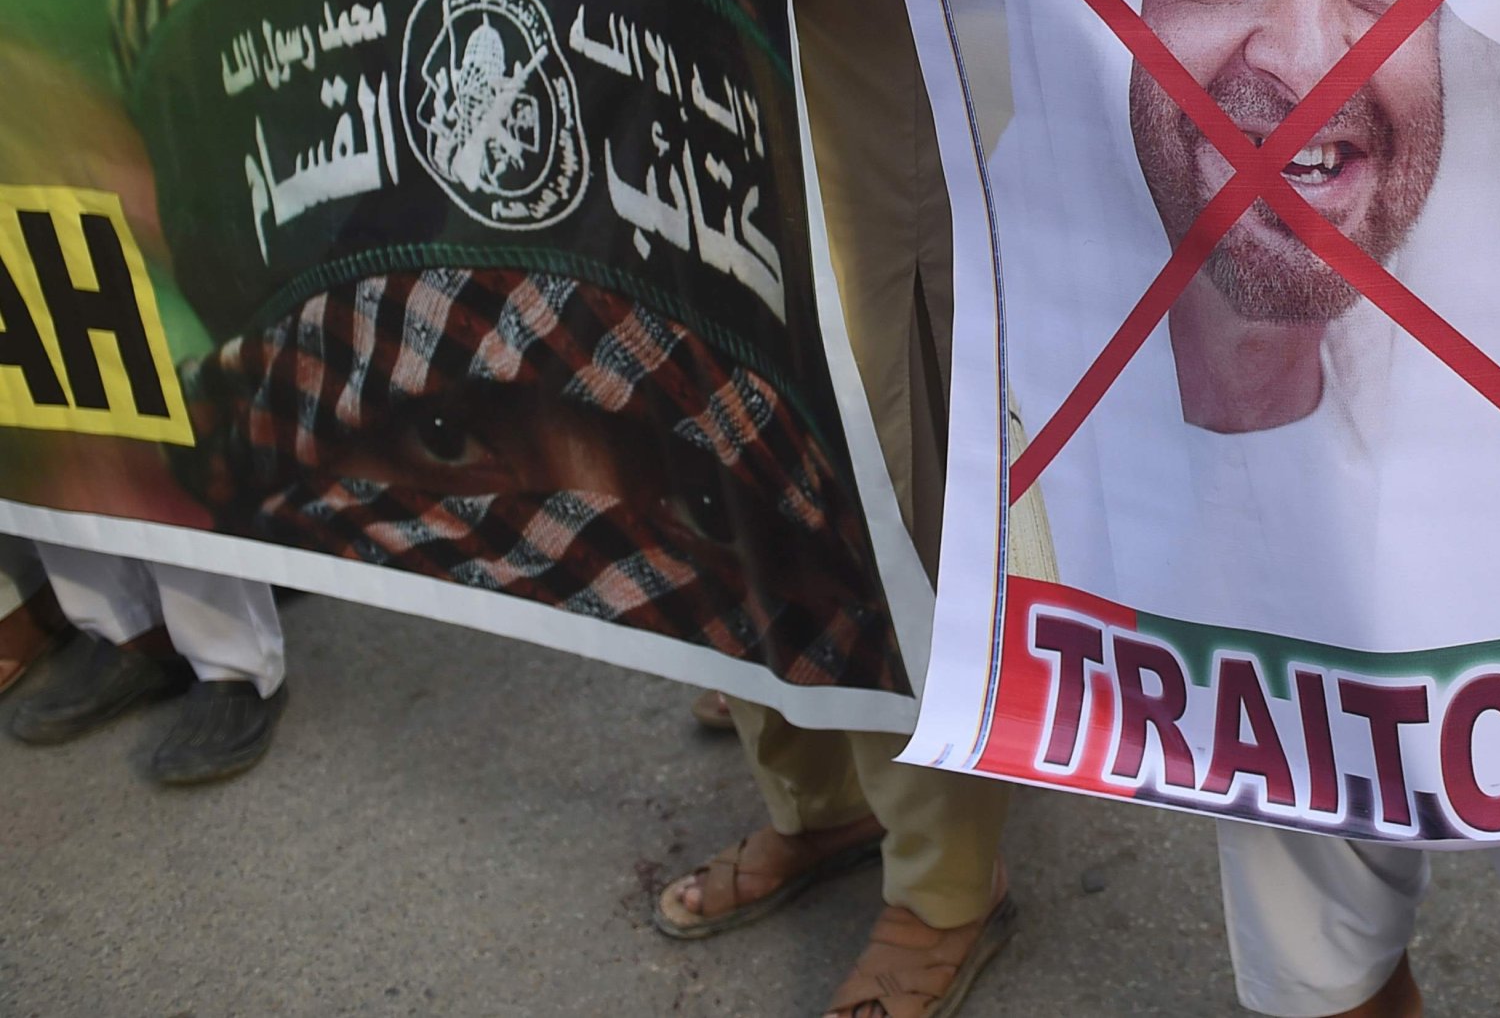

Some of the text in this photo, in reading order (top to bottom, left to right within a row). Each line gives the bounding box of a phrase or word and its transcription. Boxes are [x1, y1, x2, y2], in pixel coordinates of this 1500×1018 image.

[221, 28, 261, 96] الله
[262, 18, 316, 91] رسول
[318, 0, 387, 52] محمد
[568, 3, 644, 81] الله
[244, 70, 400, 265] القسام
